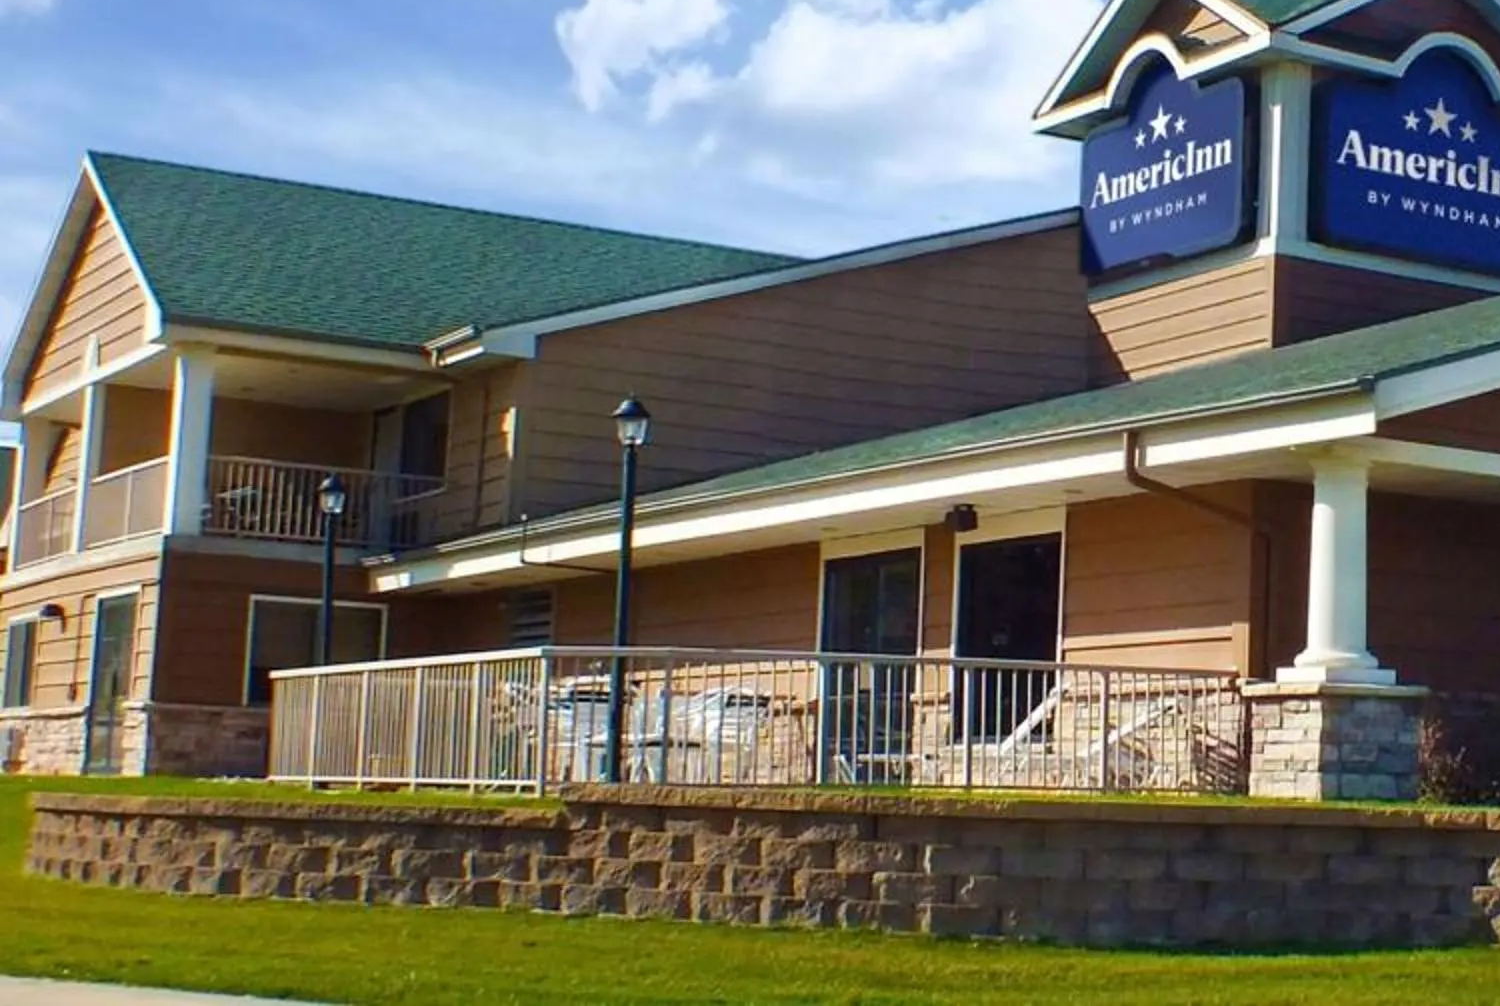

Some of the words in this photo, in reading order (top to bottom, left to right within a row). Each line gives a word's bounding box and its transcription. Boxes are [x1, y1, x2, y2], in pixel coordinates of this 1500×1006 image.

[1089, 138, 1233, 209] AmericInn
[1109, 216, 1125, 234] BY
[1131, 193, 1208, 226] WYNDHAM
[1367, 190, 1391, 206] BY
